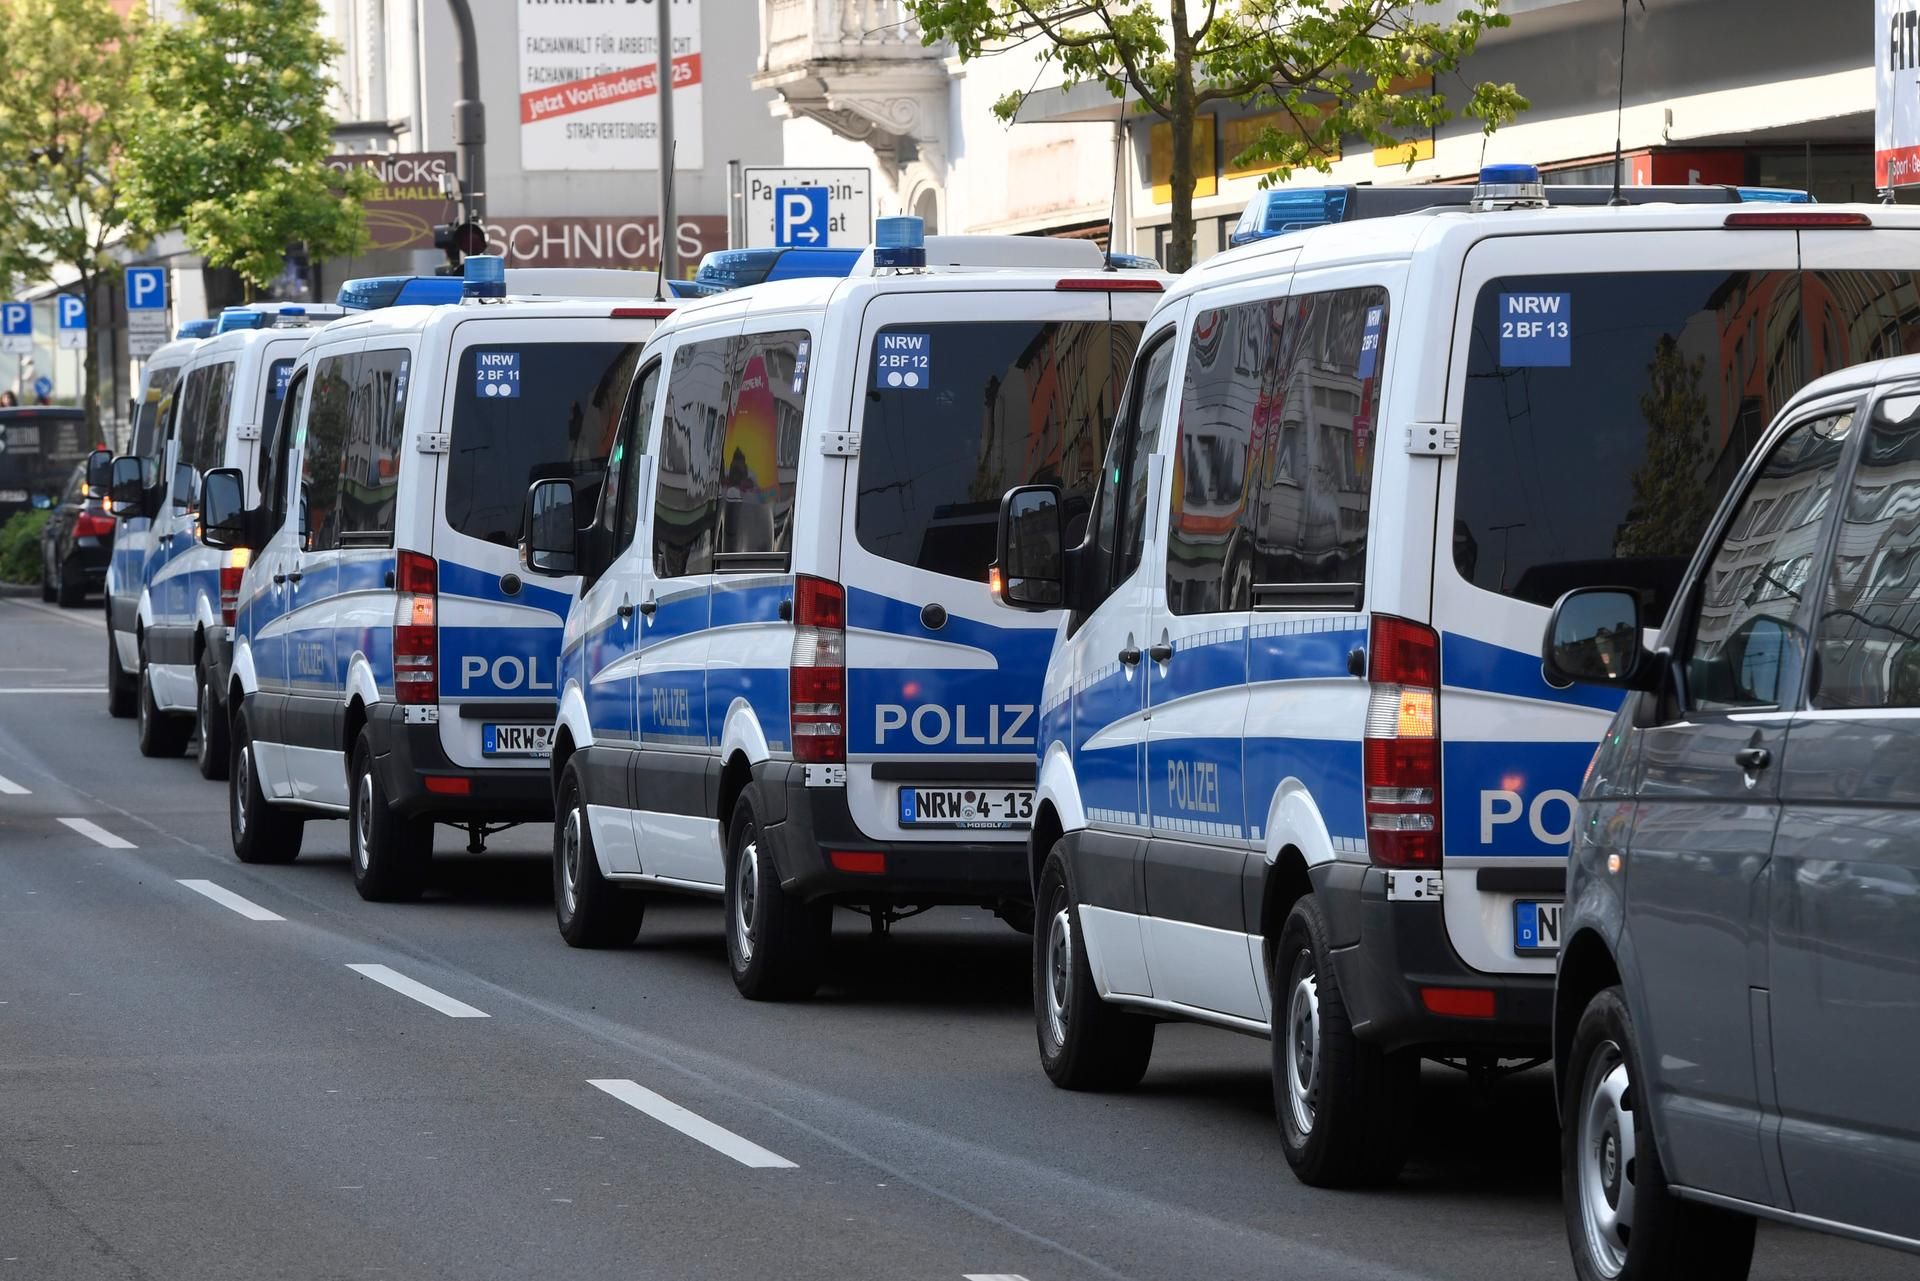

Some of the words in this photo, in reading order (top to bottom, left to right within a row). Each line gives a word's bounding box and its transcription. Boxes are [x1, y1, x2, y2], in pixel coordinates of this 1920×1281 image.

[527, 37, 591, 53] FACHANWALT
[596, 34, 614, 53] FÜR
[619, 37, 691, 53] ARBEITSCHT
[1890, 10, 1920, 71] FIT
[528, 67, 591, 82] FACHANWALT
[529, 94, 565, 119] jetzt
[566, 71, 659, 106] Vorländerst
[672, 63, 692, 82] 25
[566, 122, 658, 139] STRAFVERTEIDIGER
[783, 194, 813, 243] P
[134, 273, 157, 305] P
[64, 298, 84, 327] P
[1509, 297, 1560, 313] NRW
[7, 306, 26, 332] P
[1502, 323, 1513, 338] 2
[1517, 323, 1542, 338] BF
[1547, 322, 1568, 338] 13
[884, 336, 922, 349] NRW
[481, 355, 514, 366] NRW
[879, 356, 887, 367] 2
[890, 356, 909, 367] BF
[911, 355, 928, 368] 12
[477, 371, 485, 380] 2
[488, 370, 504, 380] BF
[508, 370, 519, 380] 11
[298, 643, 324, 675] POLIZEI
[652, 688, 690, 728] POLIZEI
[875, 704, 1037, 745] POLIZ
[496, 727, 535, 749] NRW
[1167, 759, 1220, 813] POLIZEI
[904, 808, 912, 817] D
[915, 791, 962, 818] NRW
[1523, 929, 1532, 940] D
